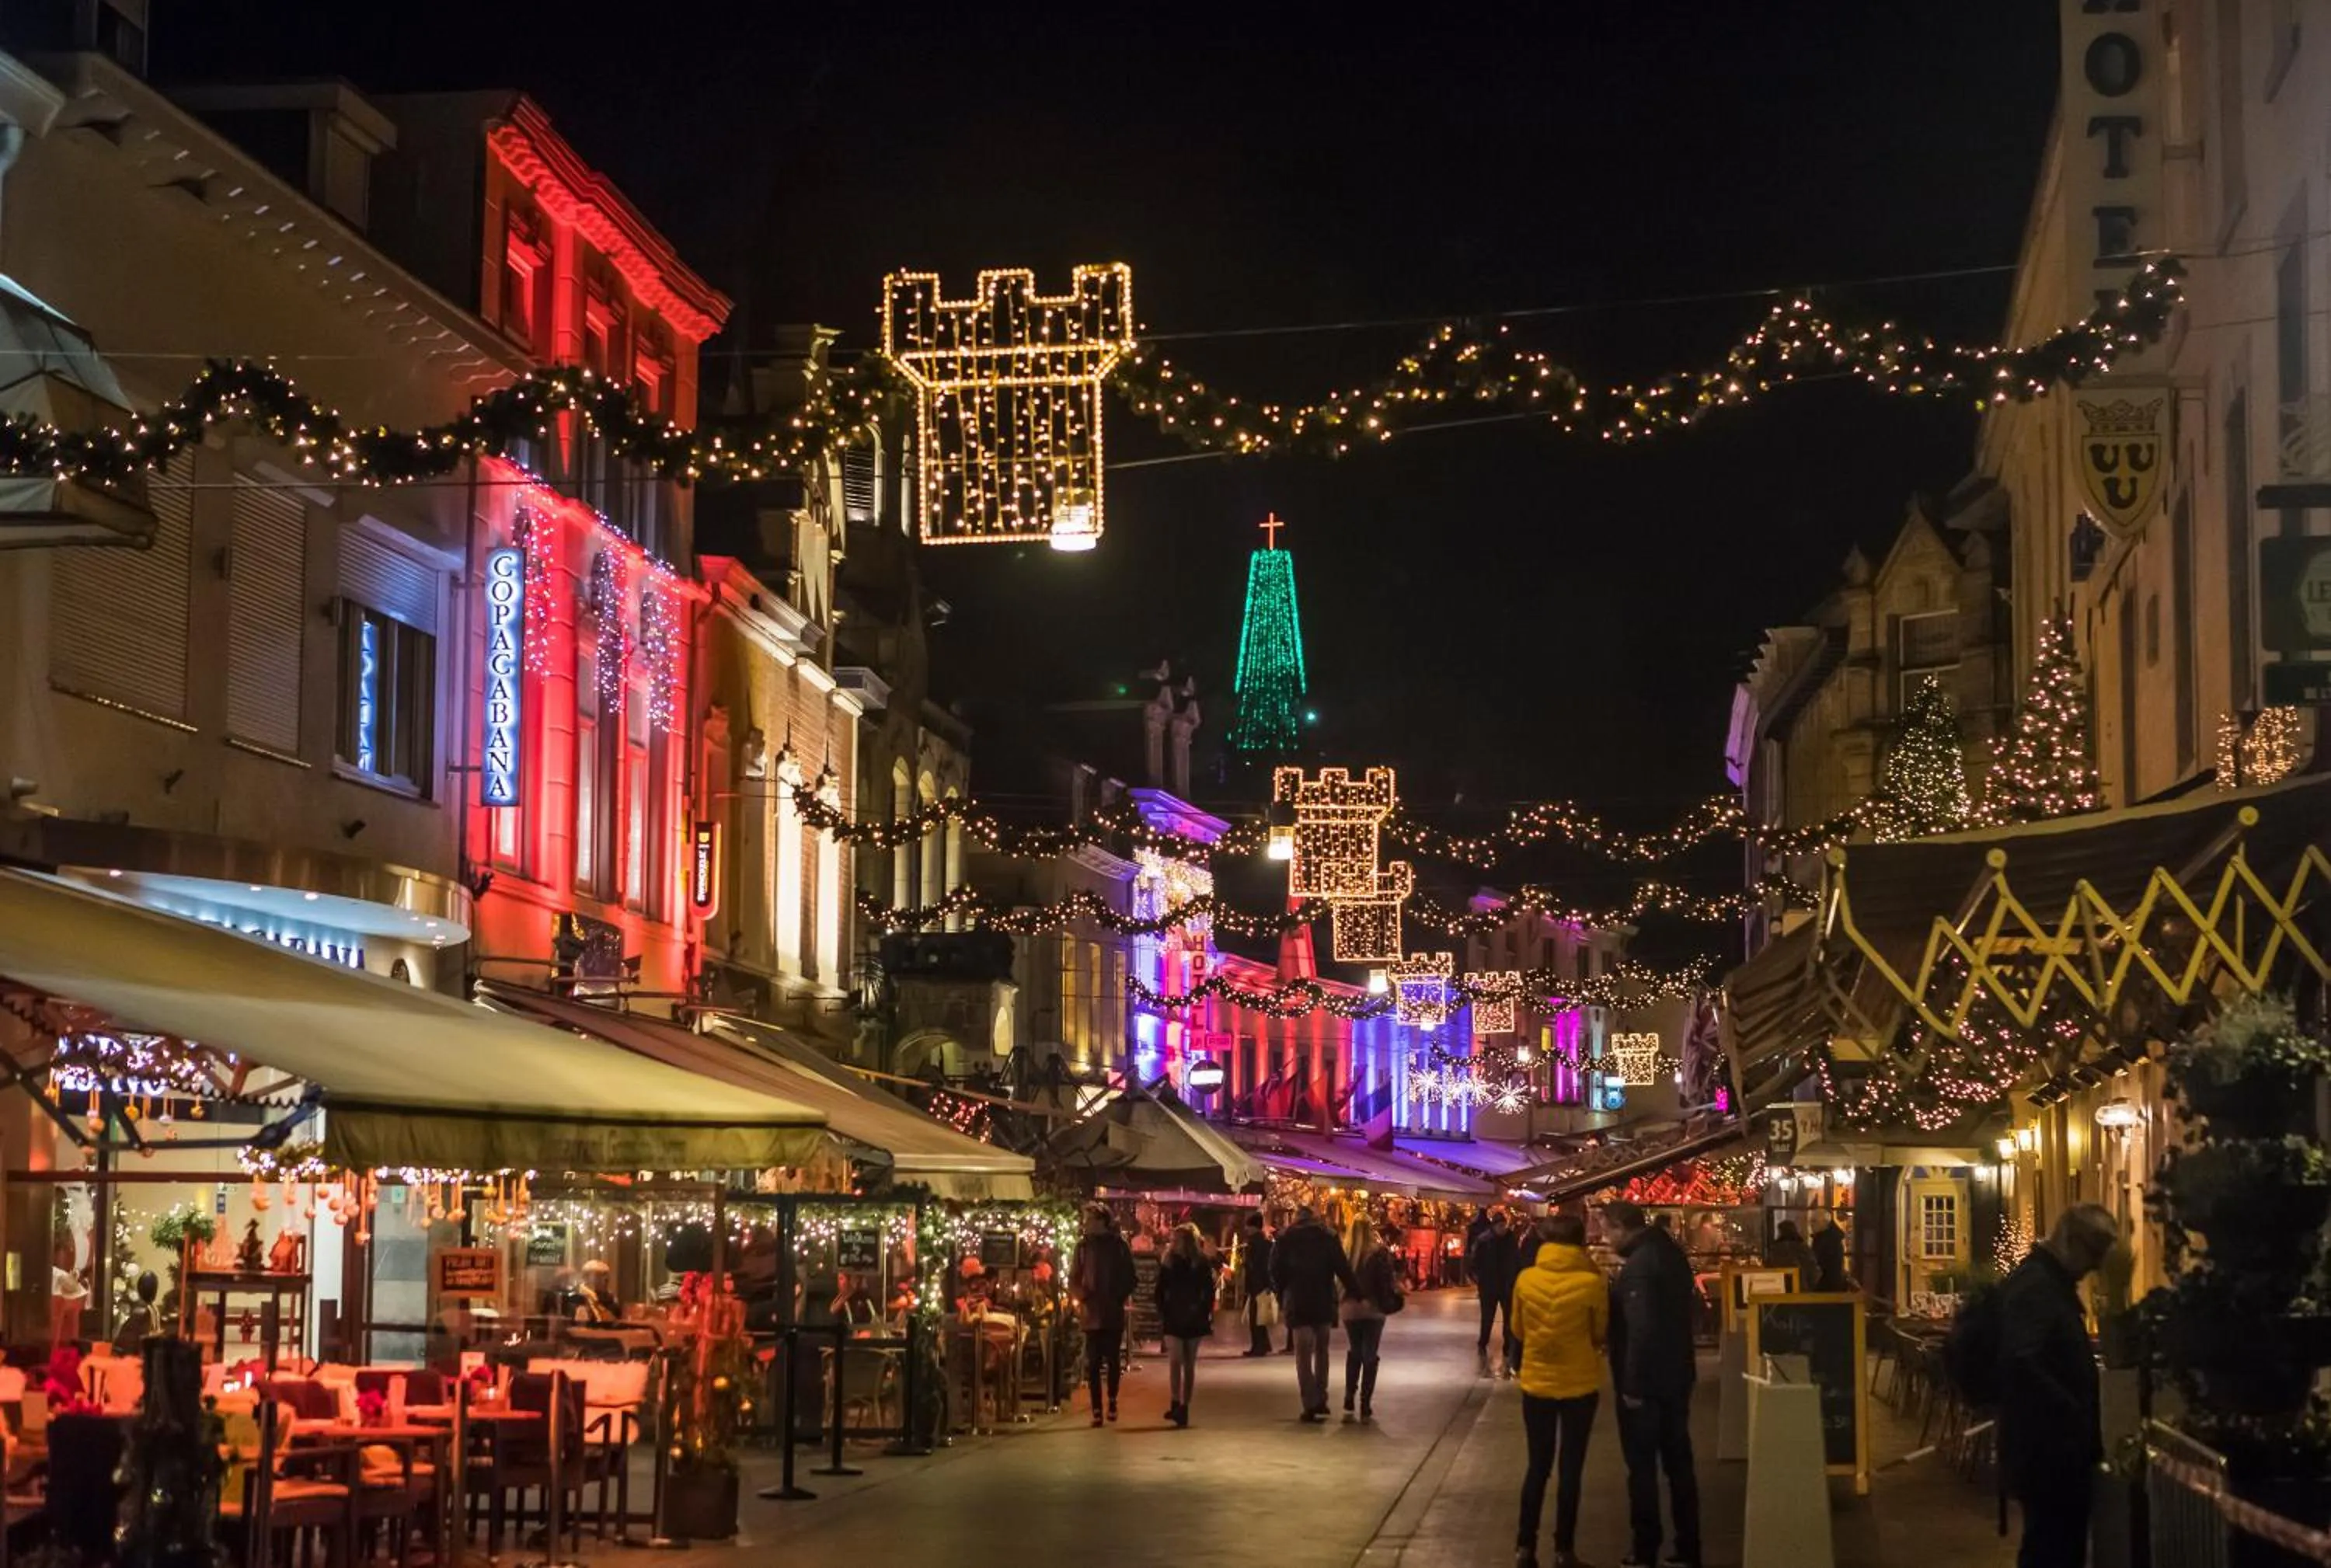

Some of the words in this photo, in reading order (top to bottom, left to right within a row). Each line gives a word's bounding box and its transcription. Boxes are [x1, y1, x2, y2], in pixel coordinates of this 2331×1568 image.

[489, 556, 514, 797] COPACABANA
[1192, 935, 1204, 1030] HOTL
[1768, 1119, 1793, 1140] 35
